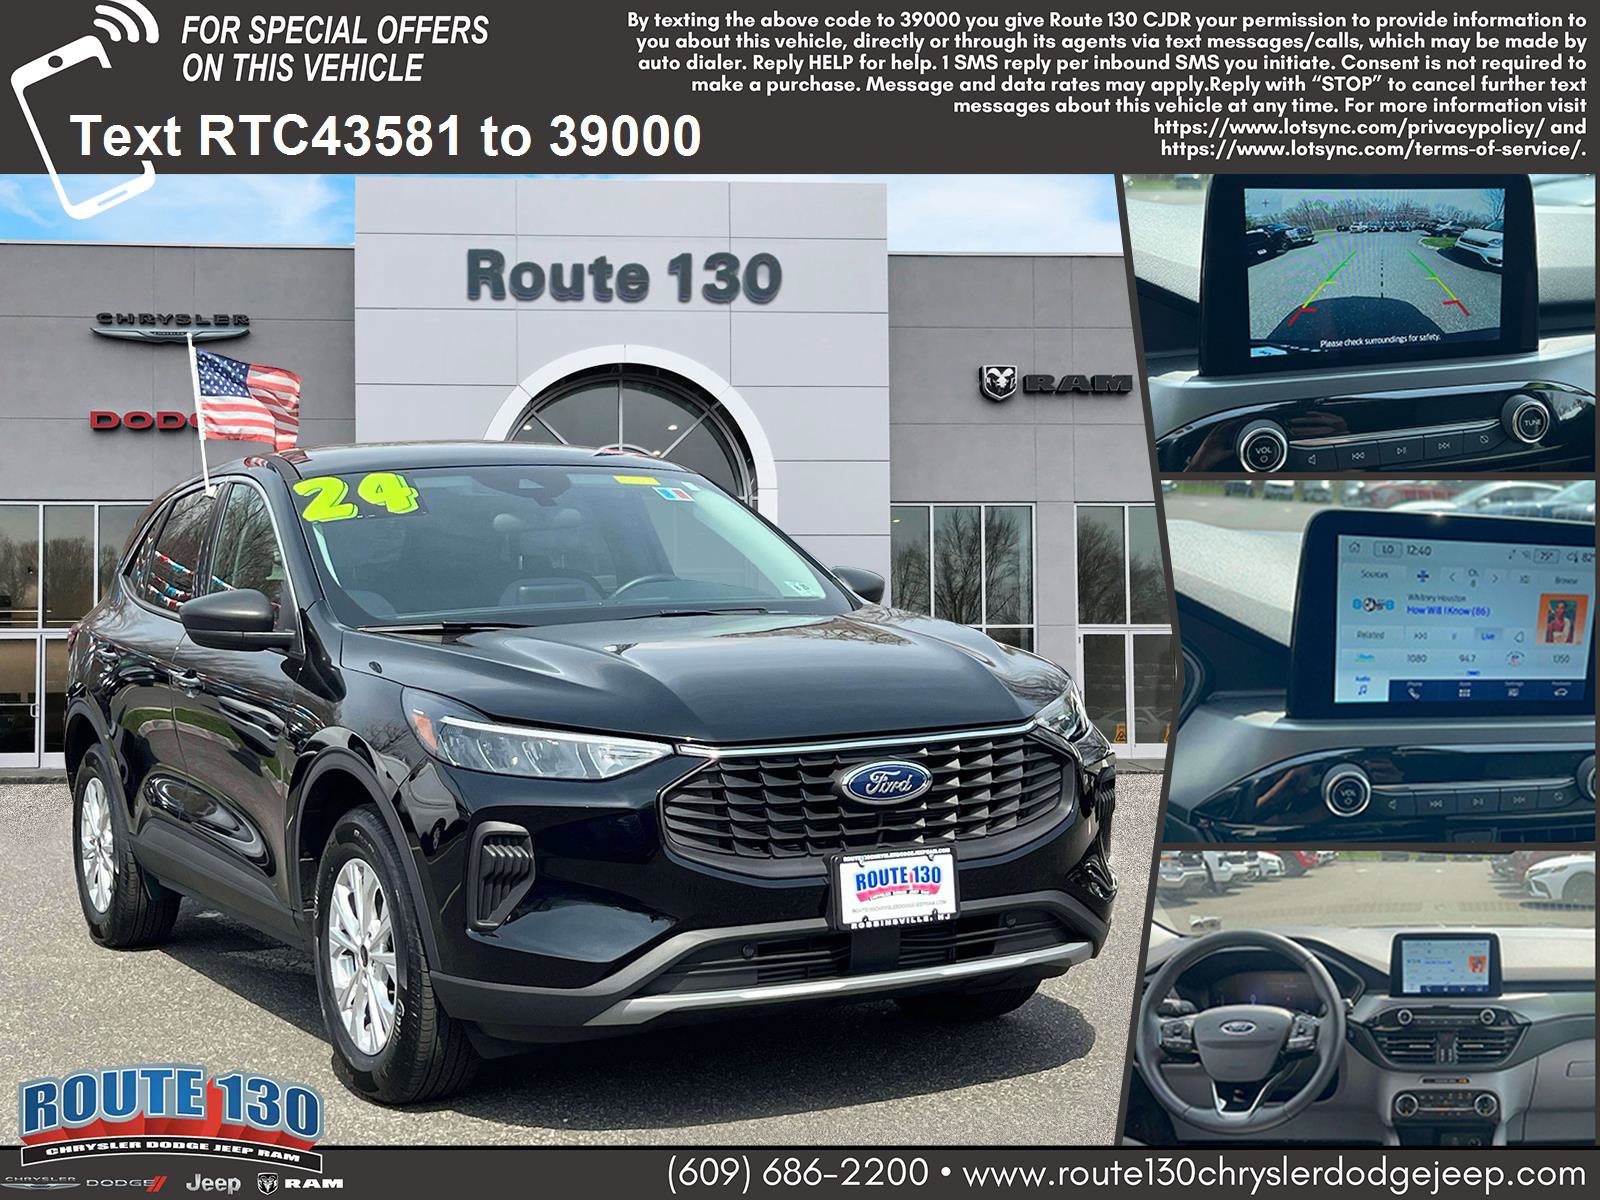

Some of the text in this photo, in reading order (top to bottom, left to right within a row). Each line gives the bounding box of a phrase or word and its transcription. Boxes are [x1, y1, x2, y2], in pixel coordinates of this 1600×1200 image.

[466, 249, 782, 304] Route 130
[96, 312, 250, 326] CHRYSLER
[1320, 333, 1441, 348] Please check surroundings for safety.
[1023, 374, 1133, 394] RAM
[89, 410, 199, 432] DOD
[1524, 418, 1542, 426] TUNE
[1255, 446, 1272, 454] VOL
[293, 472, 419, 522] 24
[1406, 545, 1432, 556] 12:40
[1407, 605, 1426, 615] How
[1427, 605, 1443, 615] Will
[1448, 606, 1470, 616] Know
[865, 770, 913, 796] Ford
[855, 865, 942, 891] ROUTE 130
[937, 912, 951, 921] NJ
